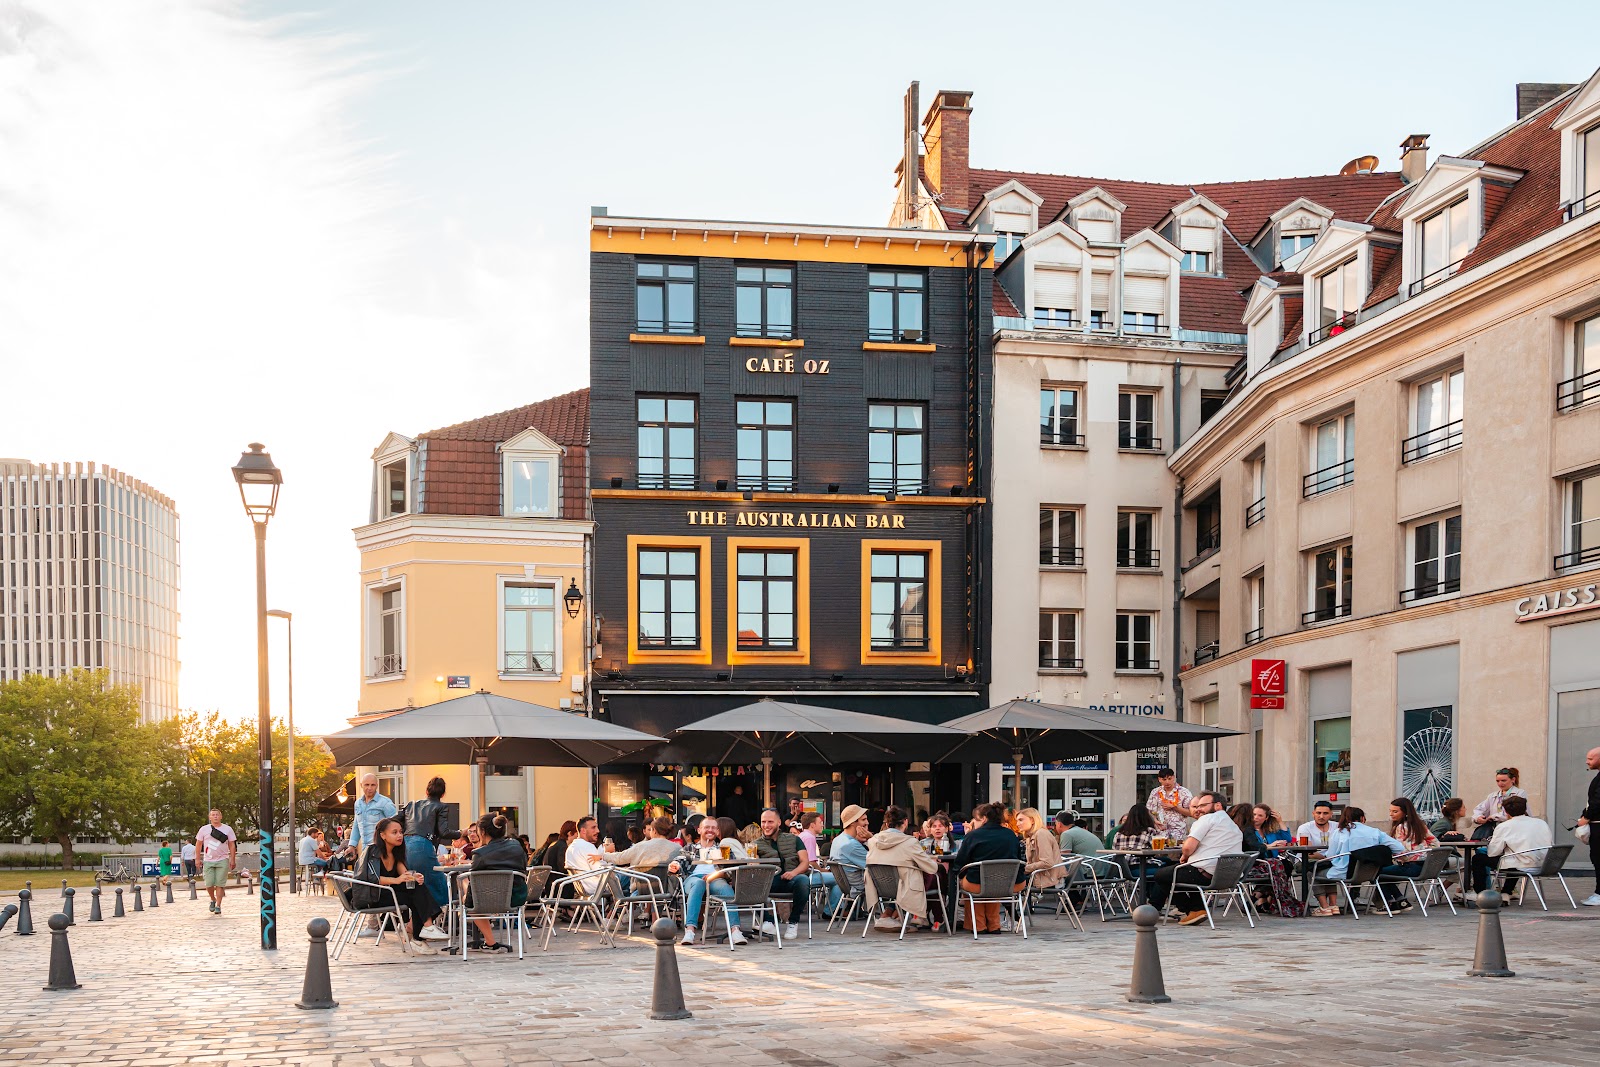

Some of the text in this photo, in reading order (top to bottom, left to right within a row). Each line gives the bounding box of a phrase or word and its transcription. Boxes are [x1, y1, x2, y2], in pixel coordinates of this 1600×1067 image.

[745, 353, 830, 374] CAFÉ OZ
[687, 510, 906, 529] THE AUSTRALIAN BAR
[691, 765, 746, 777] ALOHA
[144, 865, 152, 875] P
